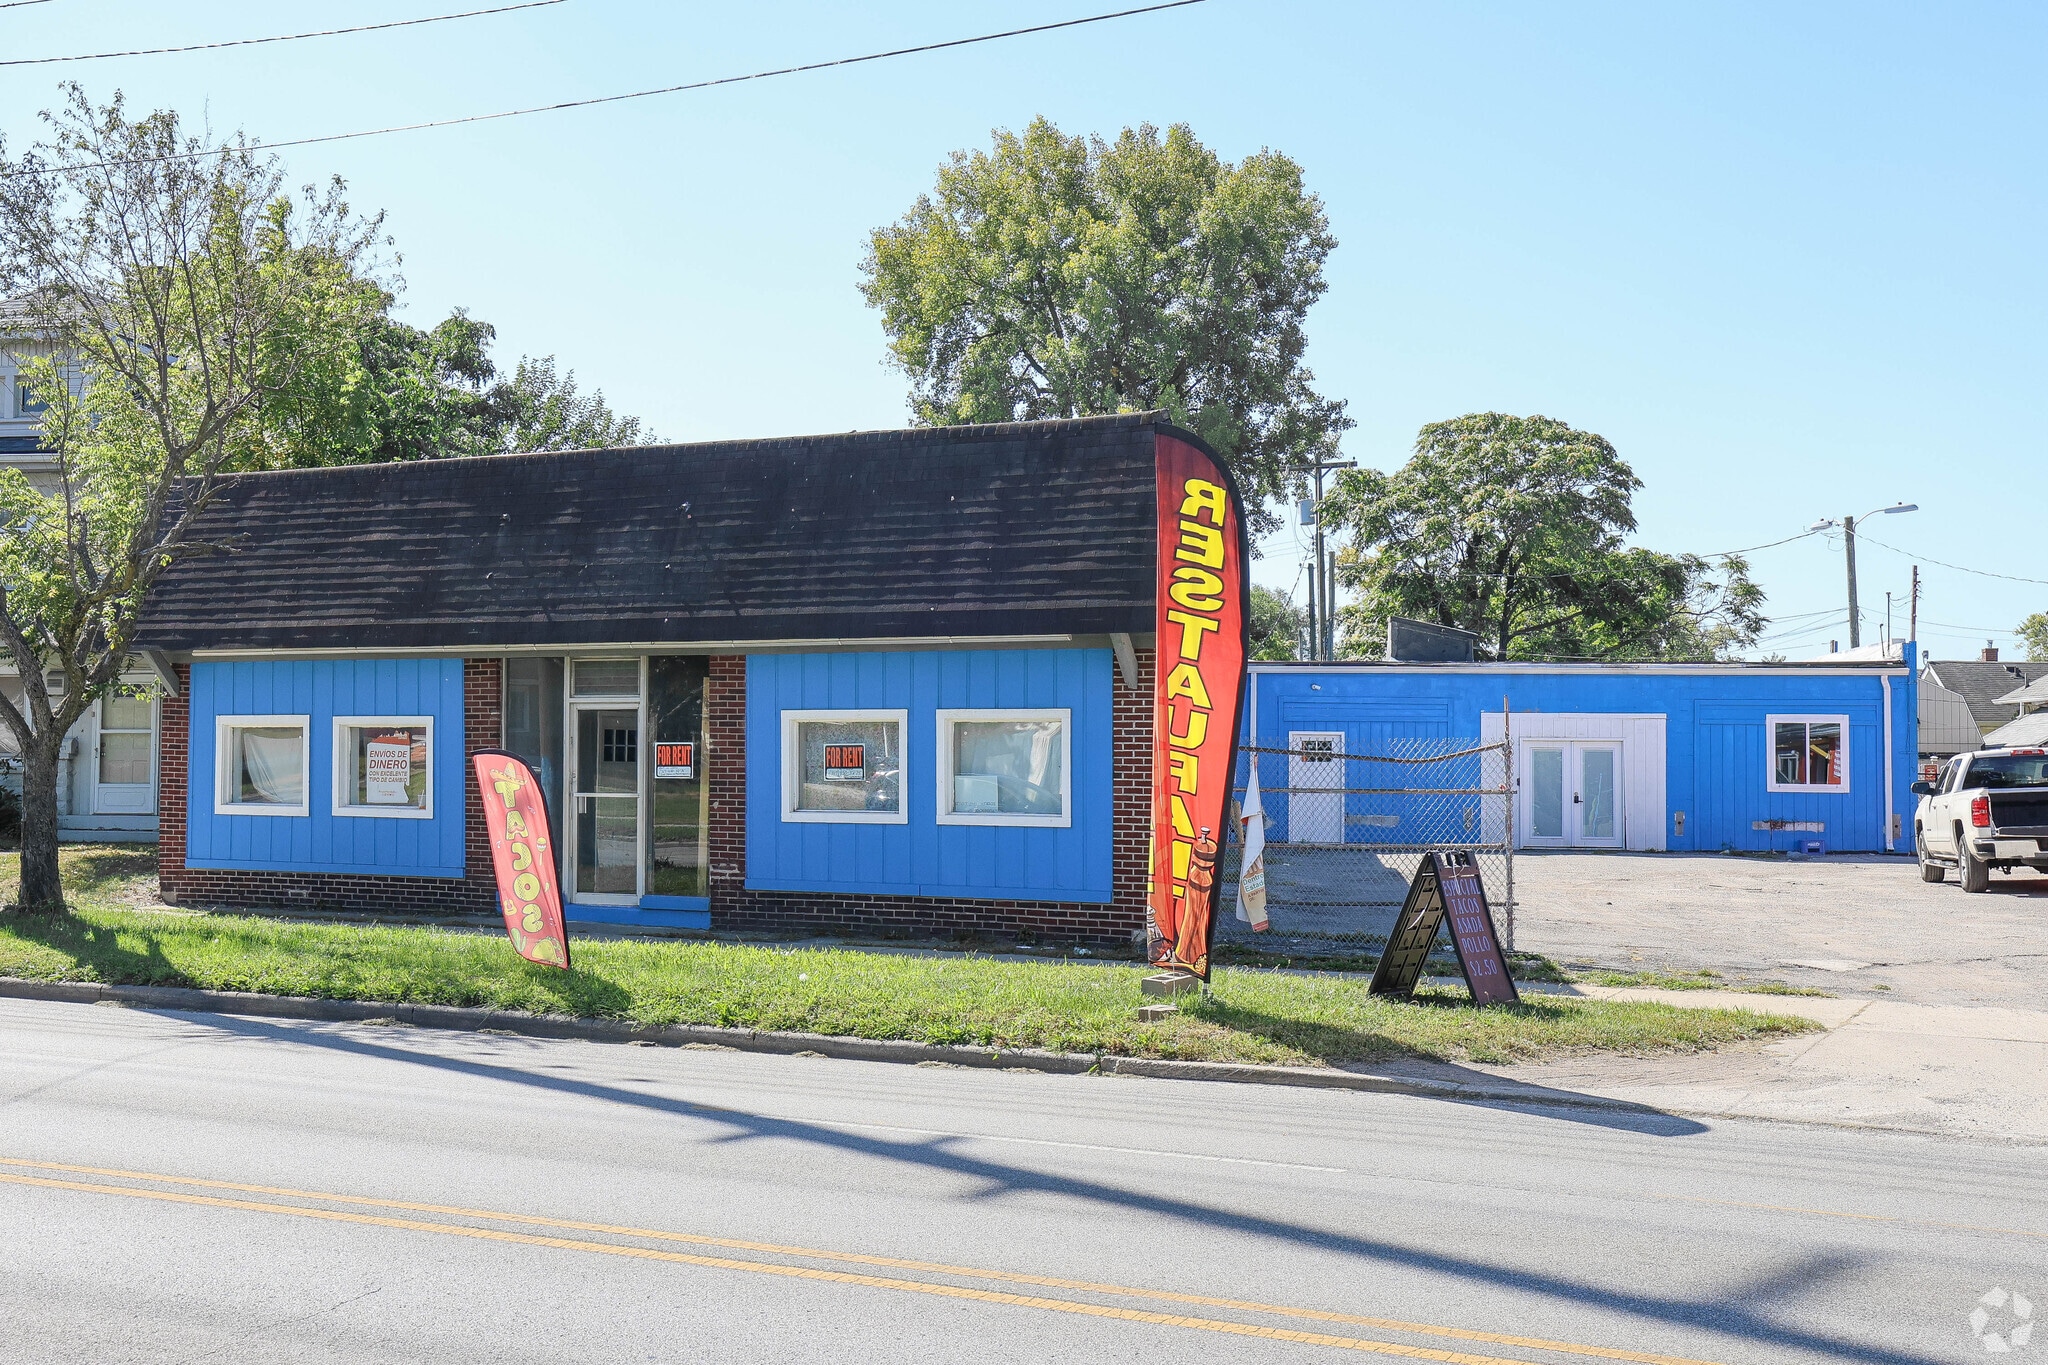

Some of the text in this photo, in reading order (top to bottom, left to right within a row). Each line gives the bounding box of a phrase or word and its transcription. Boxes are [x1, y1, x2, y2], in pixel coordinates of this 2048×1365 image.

[369, 749, 408, 758] ENVÍOS DE
[657, 745, 692, 766] FOR RENT
[826, 746, 863, 768] FOR RENT
[369, 760, 408, 770] DINERO
[1451, 898, 1480, 915] TACOS
[1457, 916, 1485, 934] ASADA
[1461, 936, 1491, 954] POLLO
[1469, 958, 1498, 977] $2.50
